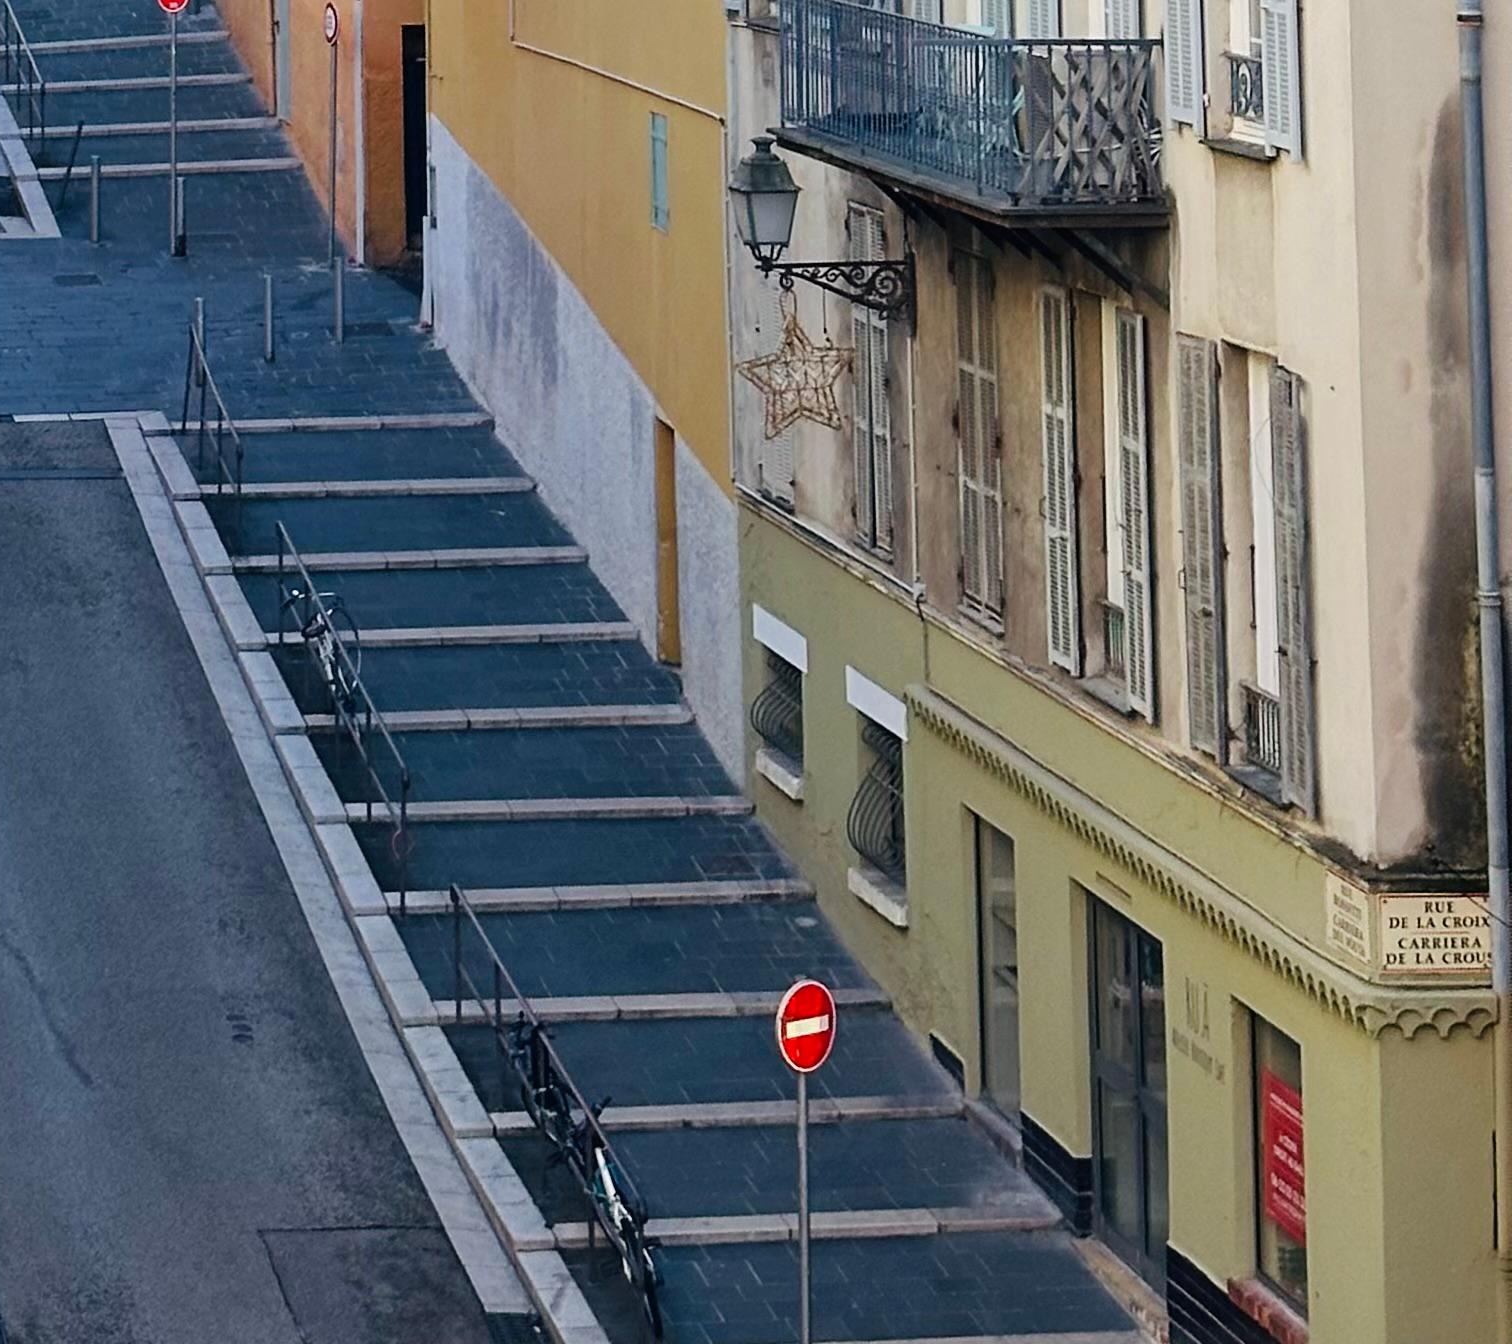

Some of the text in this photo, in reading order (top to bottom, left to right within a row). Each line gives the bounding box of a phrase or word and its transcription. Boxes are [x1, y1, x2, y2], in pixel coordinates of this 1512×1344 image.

[1424, 901, 1455, 913] RUE
[1389, 916, 1491, 929] DE LA CROIX
[1398, 936, 1481, 949] CARRIERA
[1386, 953, 1406, 965] DE
[1416, 953, 1435, 965] LA
